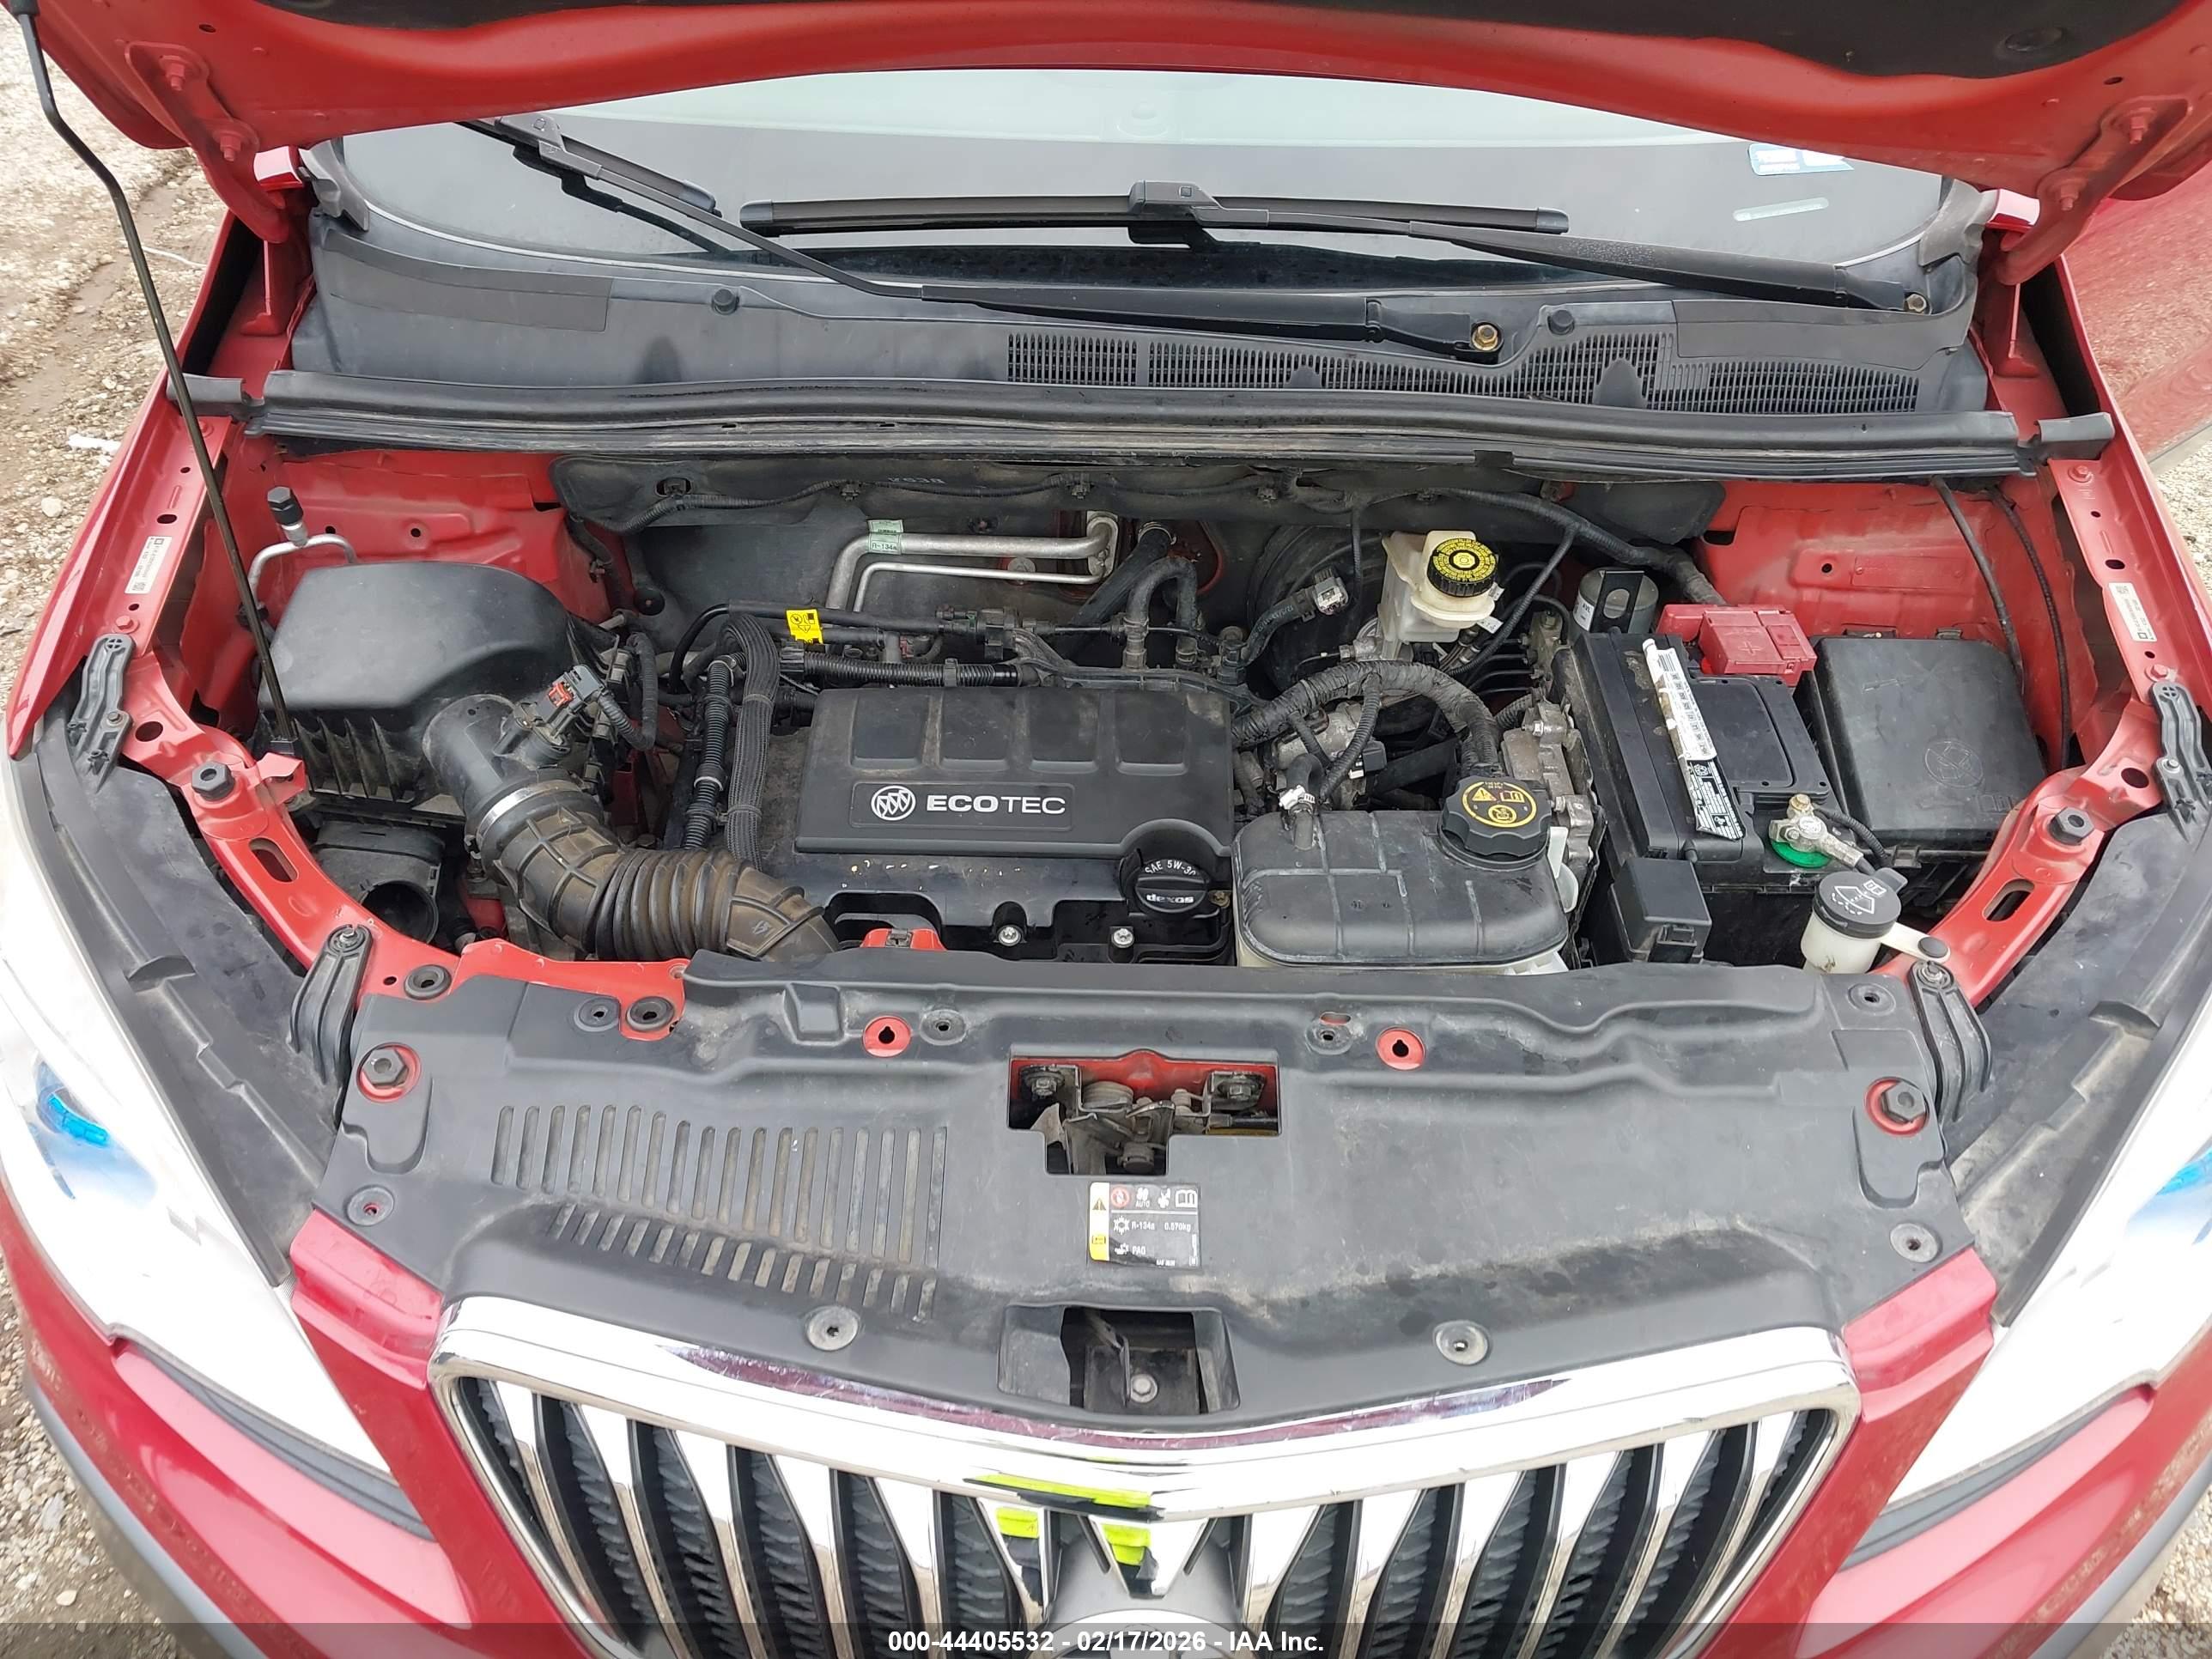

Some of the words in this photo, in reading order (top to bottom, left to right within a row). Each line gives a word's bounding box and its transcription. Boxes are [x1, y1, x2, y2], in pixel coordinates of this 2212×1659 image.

[927, 794, 1066, 815] ECOTEC
[1145, 860, 1164, 874] SAE
[1135, 1200, 1151, 1208] AUTO
